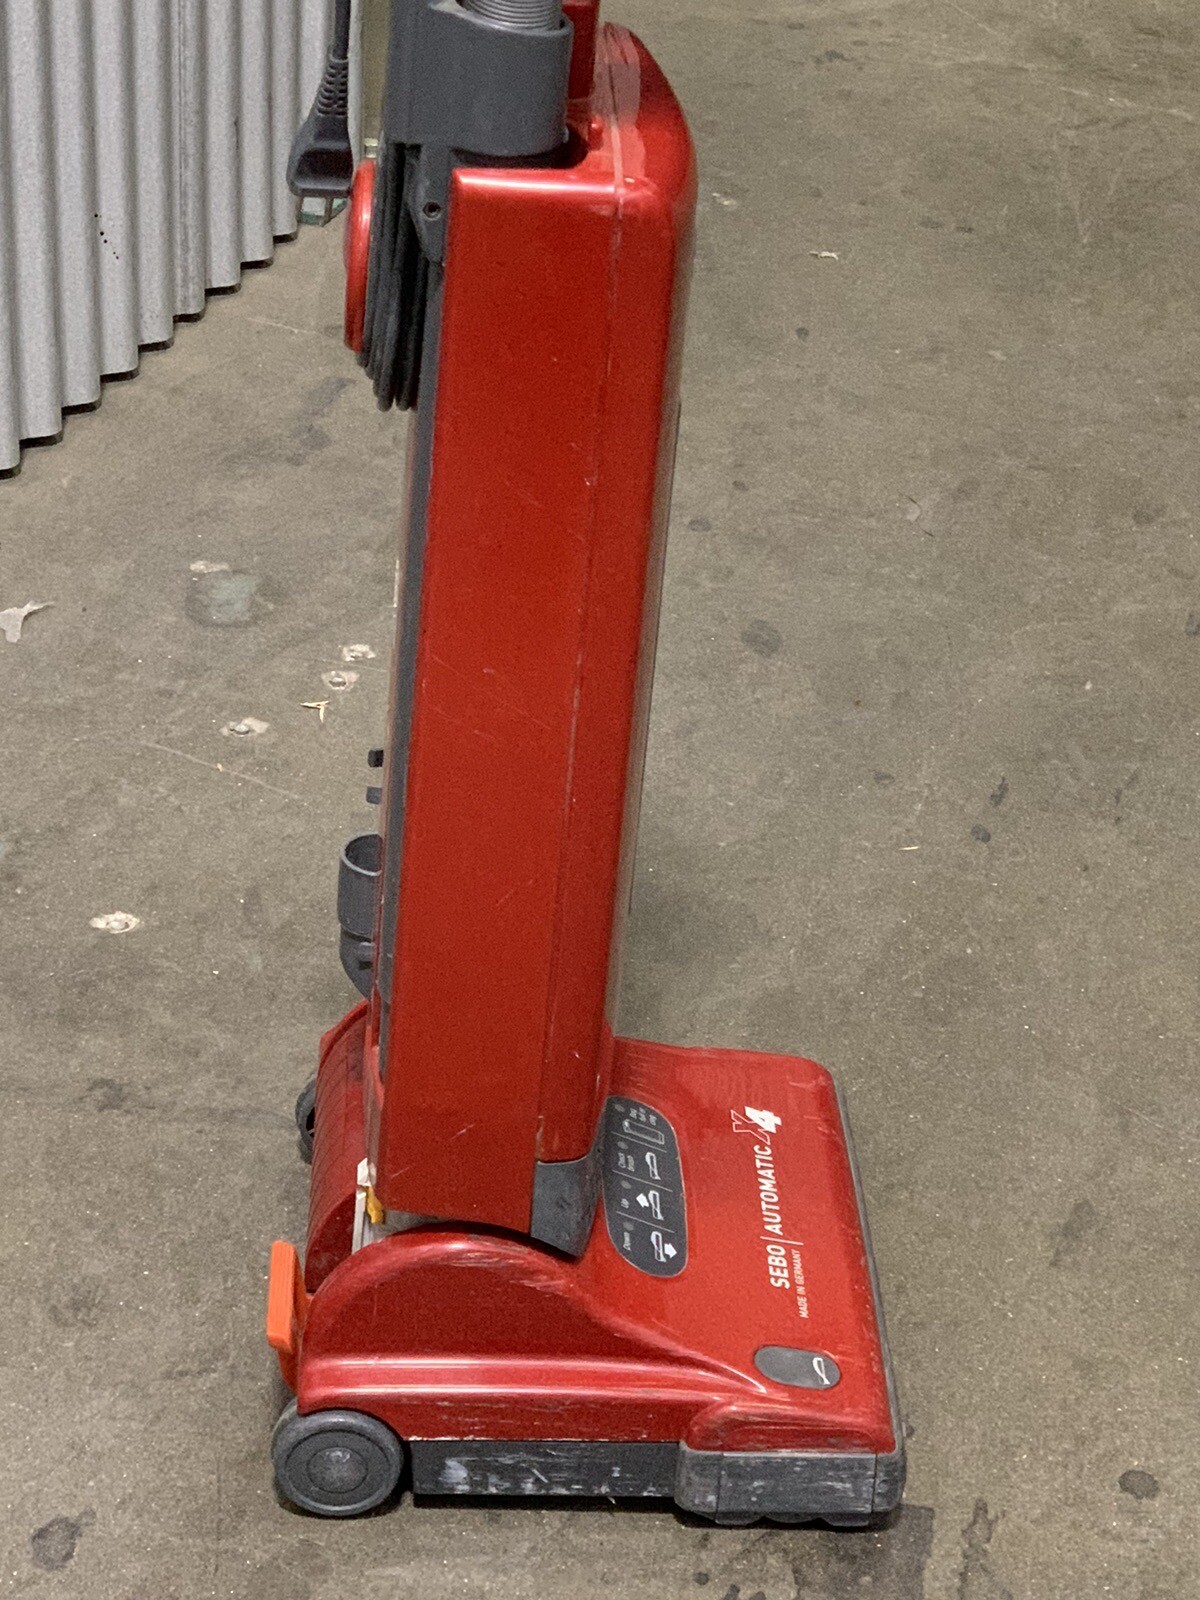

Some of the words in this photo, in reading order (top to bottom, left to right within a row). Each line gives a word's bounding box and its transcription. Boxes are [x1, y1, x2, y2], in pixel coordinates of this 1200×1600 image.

[753, 1145, 783, 1236] AUTOMATIC
[766, 1244, 791, 1290] SEBO
[791, 1249, 804, 1285] GERMANY
[796, 1285, 806, 1295] IN
[797, 1296, 809, 1319] MADE
